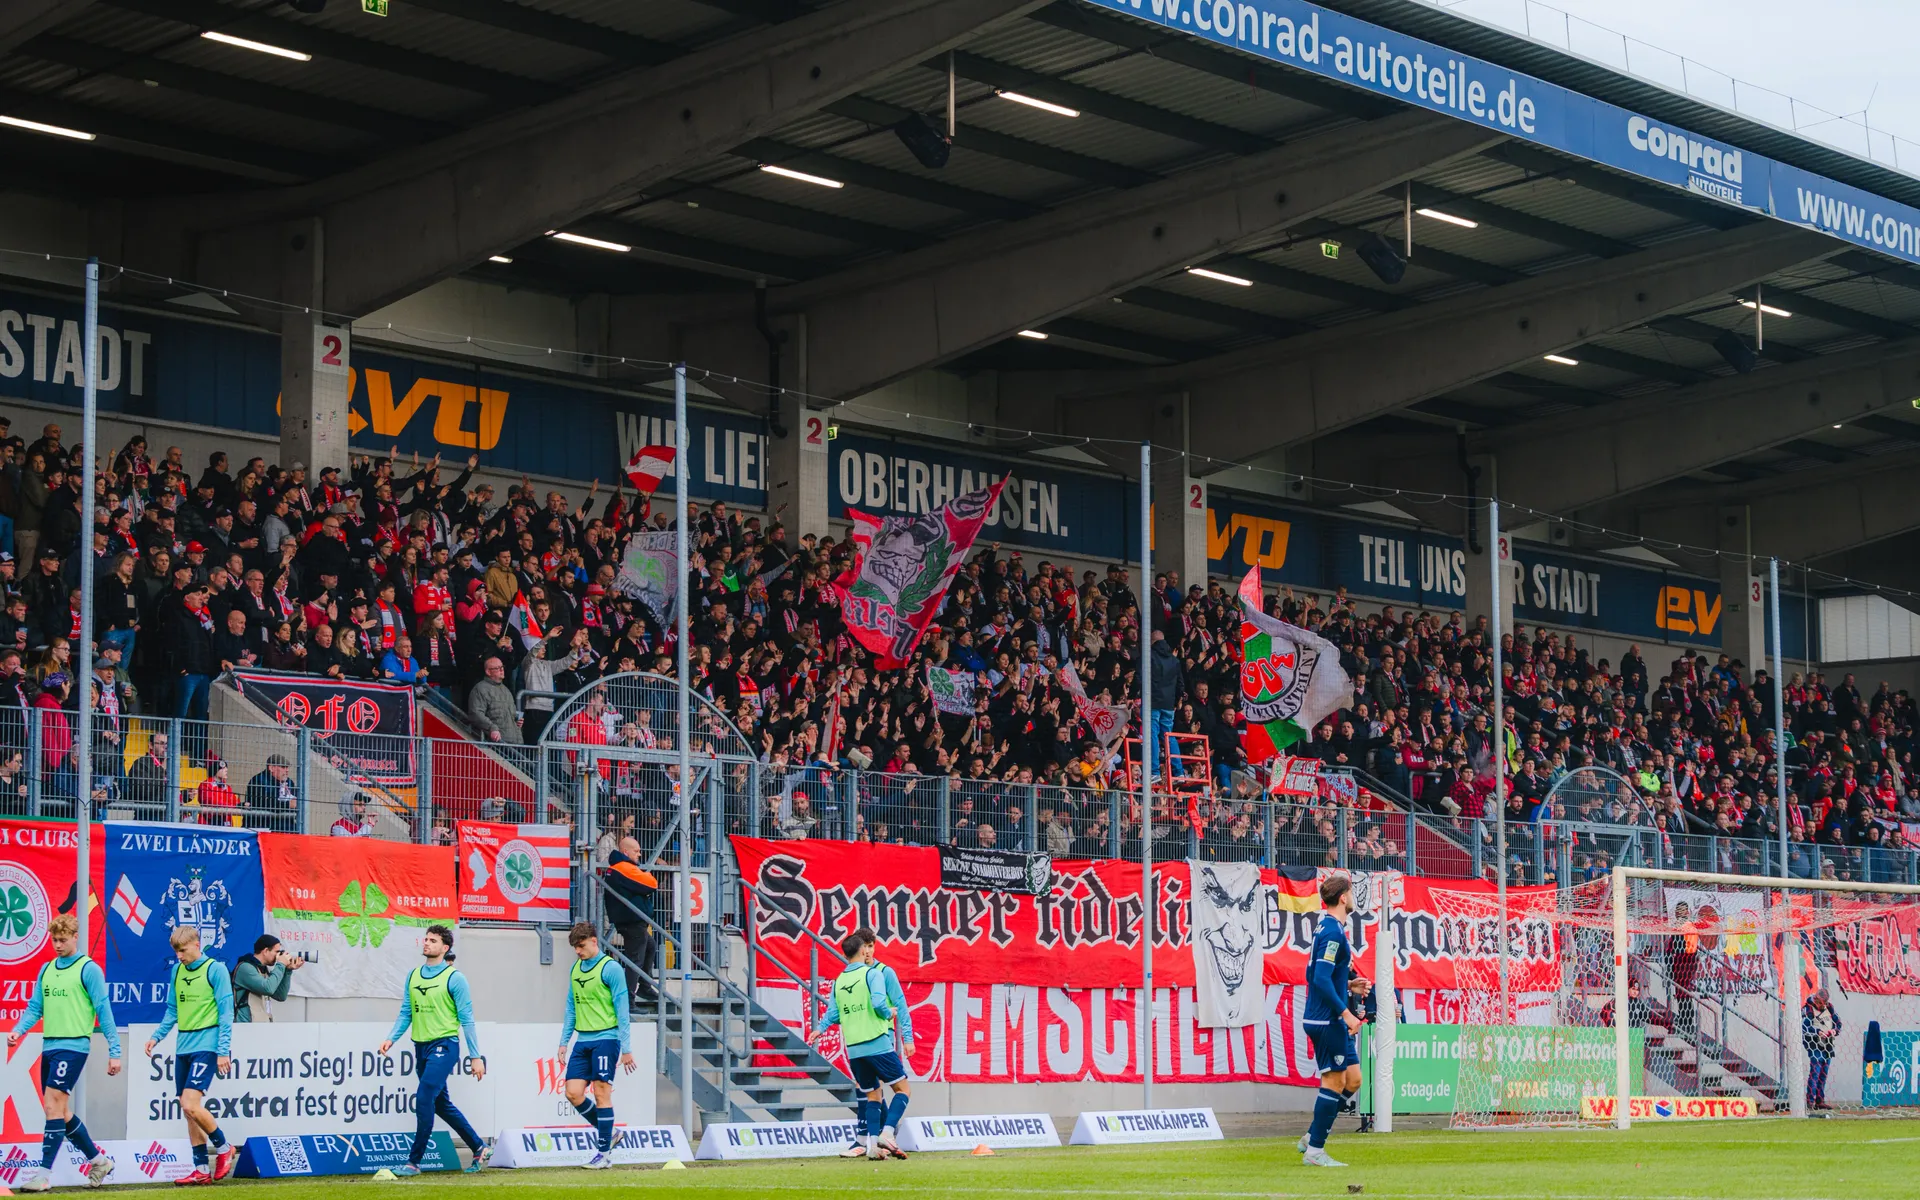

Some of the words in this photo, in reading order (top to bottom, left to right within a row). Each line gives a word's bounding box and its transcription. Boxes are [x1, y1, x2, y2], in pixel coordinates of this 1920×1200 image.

[1116, 0, 1537, 134] w.conrad-autoteile.de
[1628, 115, 1743, 184] Conrad
[0, 309, 152, 396] STADT
[322, 334, 343, 367] 2
[806, 417, 823, 445] 2
[1189, 484, 1203, 509] 2
[1498, 537, 1509, 560] 3
[1358, 534, 1411, 589] TEIL
[1532, 563, 1601, 617] STADT
[1751, 581, 1761, 603] 3
[16, 828, 79, 848] CLUBS
[120, 833, 173, 852] ZWEI
[177, 833, 252, 856] LÄNDER
[289, 887, 316, 900] 1904
[396, 895, 450, 908] GREFRATH
[756, 854, 1020, 967] Semper
[1262, 884, 1555, 970] Obrhausen
[280, 929, 333, 943] GREFRATH
[52, 987, 68, 997] Gut.
[1367, 1034, 1427, 1059] Kmm
[1431, 1034, 1449, 1059] in
[1451, 1034, 1477, 1059] die
[1482, 1035, 1551, 1062] STOAG
[1554, 1037, 1618, 1060] Fanzone
[56, 1060, 68, 1078] 8
[191, 1062, 209, 1078] 17
[246, 1056, 293, 1080] zum
[299, 1051, 354, 1086] Sieg!
[361, 1050, 395, 1077] Die
[597, 1055, 609, 1071] 11
[1400, 1079, 1451, 1102] stoag.de
[1506, 1080, 1550, 1098] STOAG
[1553, 1080, 1576, 1098] App
[149, 1091, 182, 1121] sin
[204, 1091, 289, 1120] extra
[296, 1086, 338, 1117] fest
[343, 1085, 418, 1123] gedrüc
[1587, 1098, 1653, 1118] WST
[1675, 1098, 1750, 1118] LOTTO
[920, 1115, 1047, 1138] NOTTENKÄMPER
[1096, 1110, 1210, 1133] NOTTENKÄMPER
[522, 1129, 676, 1153] NOTTENMPER
[134, 1152, 178, 1163] Fortem
